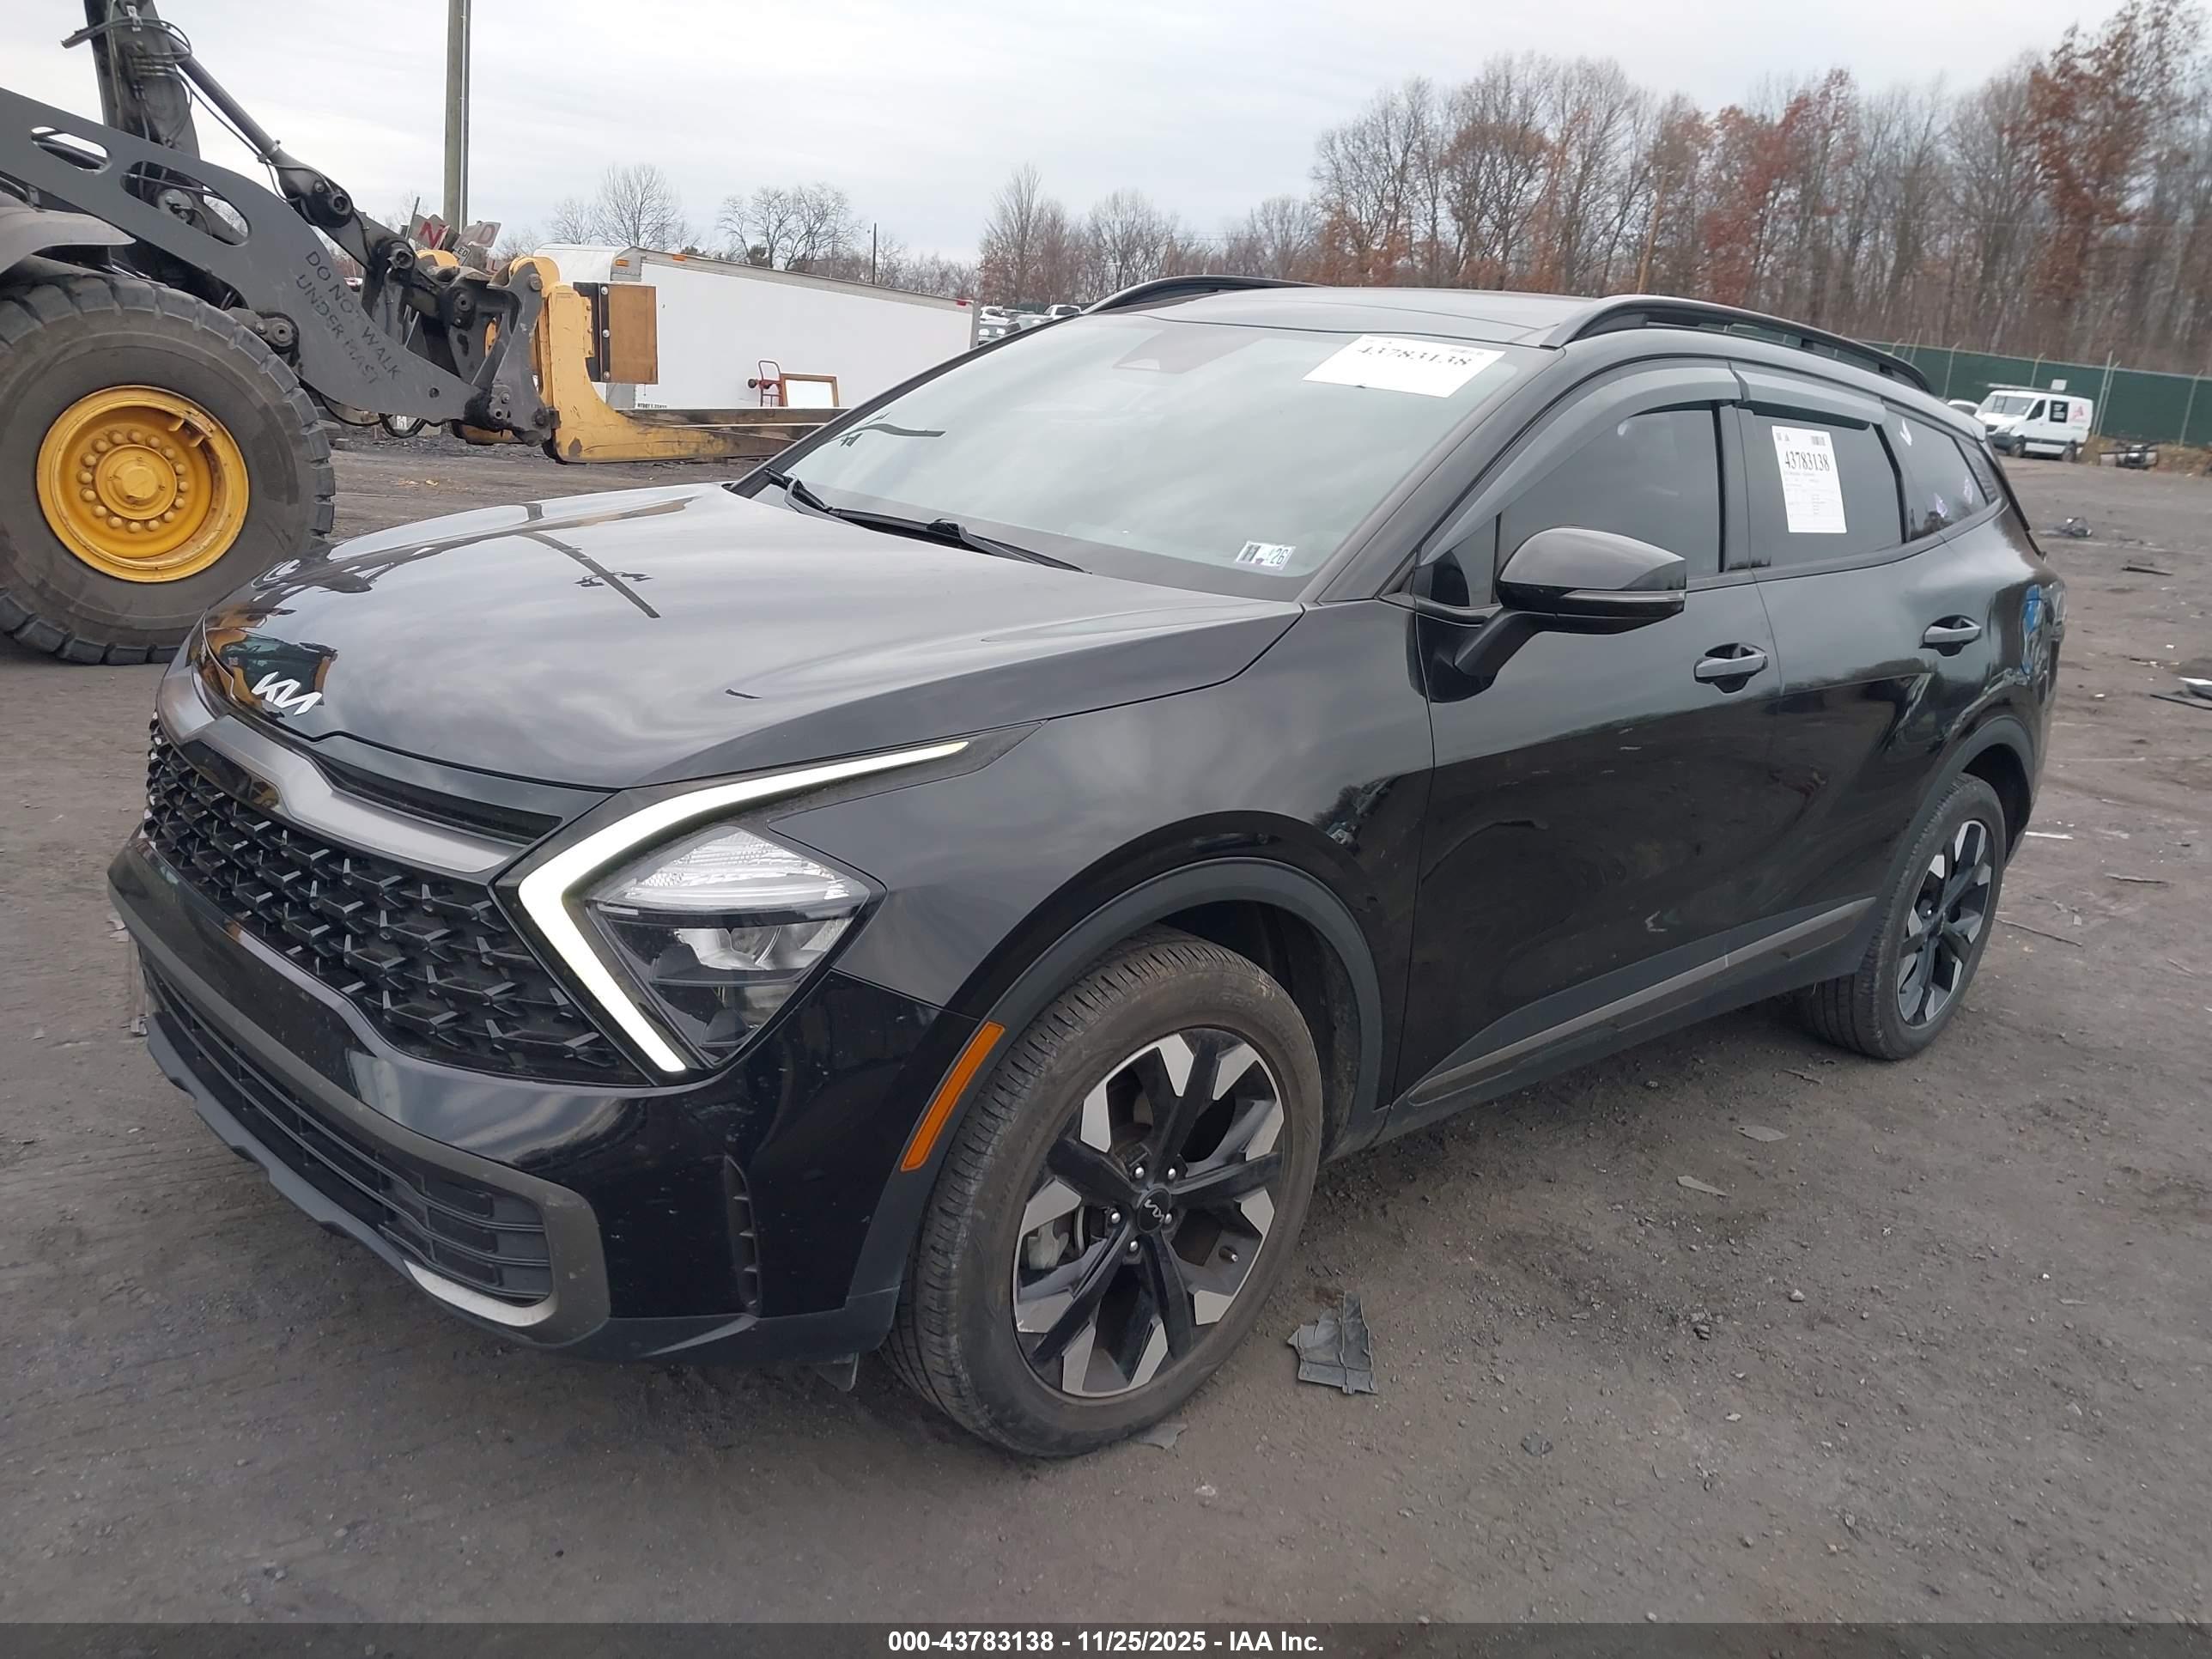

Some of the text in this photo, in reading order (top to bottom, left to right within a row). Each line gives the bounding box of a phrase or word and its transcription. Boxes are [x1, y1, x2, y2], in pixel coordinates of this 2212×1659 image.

[295, 275, 344, 339] UNDER
[306, 251, 401, 380] DO NOT WALK
[1358, 346, 1473, 366] 43783138
[1785, 451, 1831, 471] 43783138
[1270, 548, 1290, 564] 26
[252, 671, 323, 715] KIA
